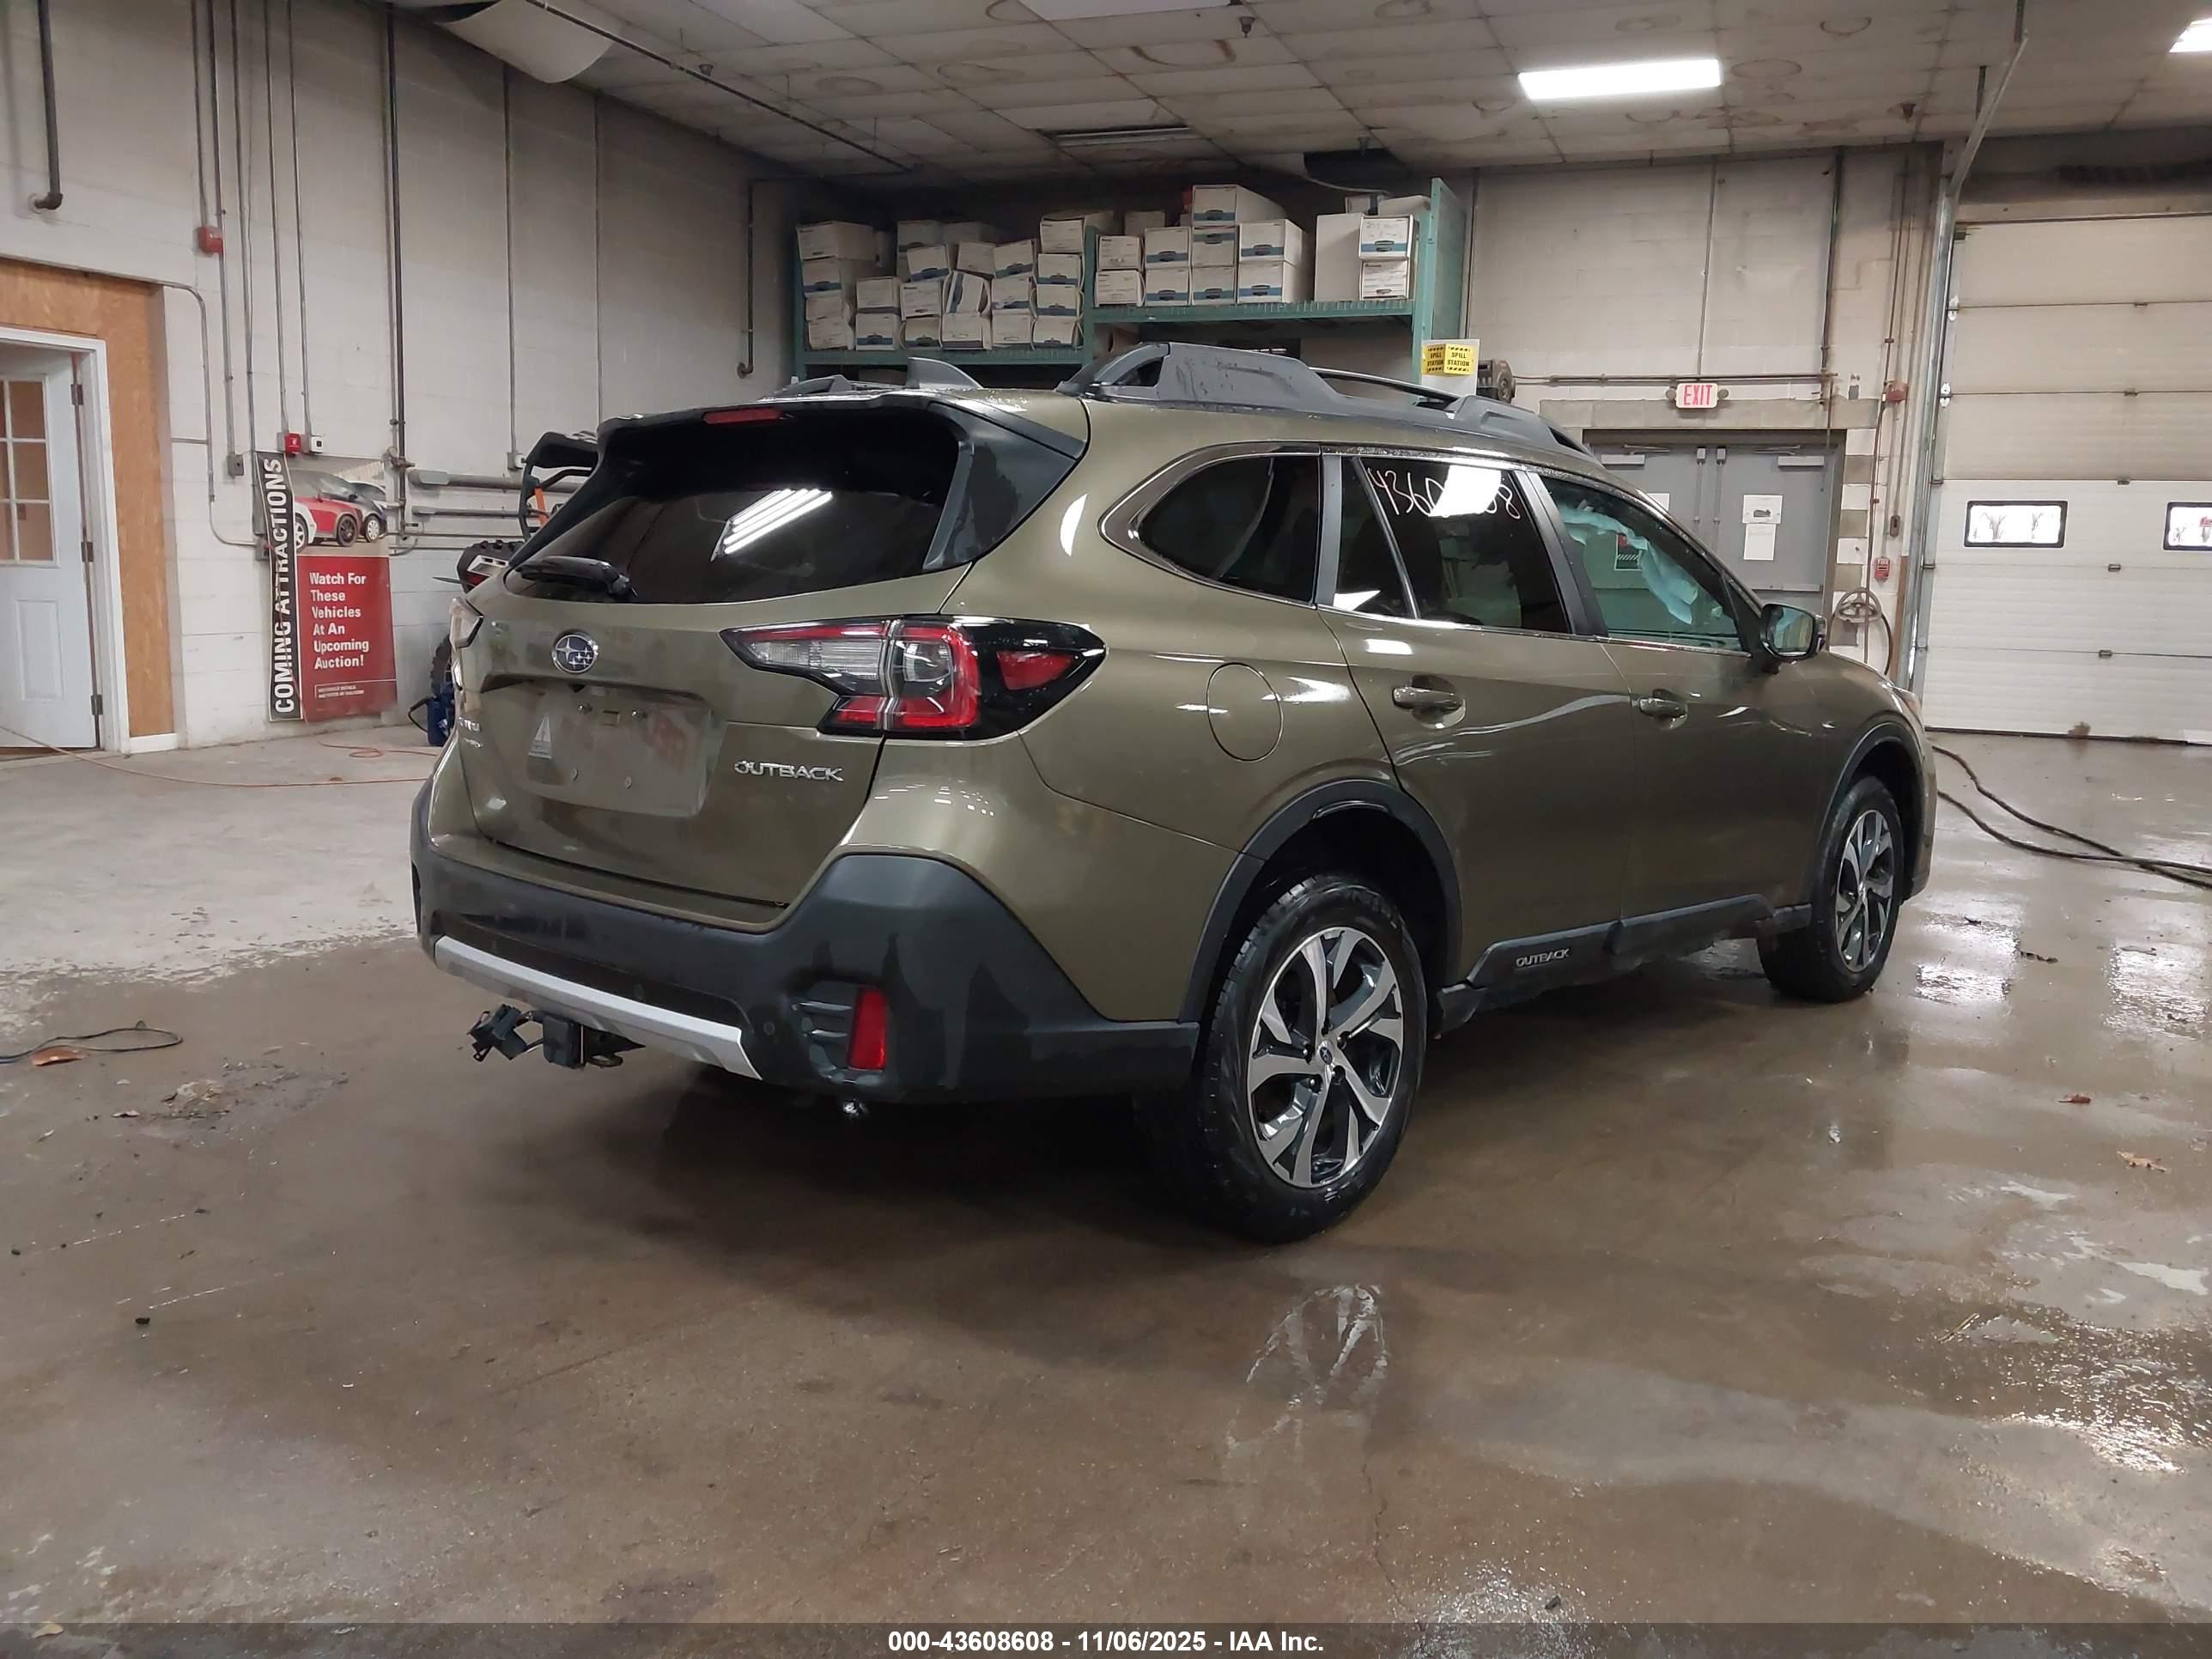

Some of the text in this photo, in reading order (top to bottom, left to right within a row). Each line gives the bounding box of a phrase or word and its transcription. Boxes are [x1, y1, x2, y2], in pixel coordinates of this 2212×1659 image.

[1683, 384, 1713, 405] EXIT
[264, 459, 295, 713] COMING ATTRACTIONS
[309, 572, 368, 585] Watch For
[310, 590, 346, 602] These
[312, 606, 362, 619] Vehicles
[313, 623, 345, 636] At An
[313, 638, 369, 654] Upcoming
[314, 654, 364, 670] Auction!
[734, 761, 844, 781] OUTBACK
[1516, 948, 1570, 967] OUTBACK
